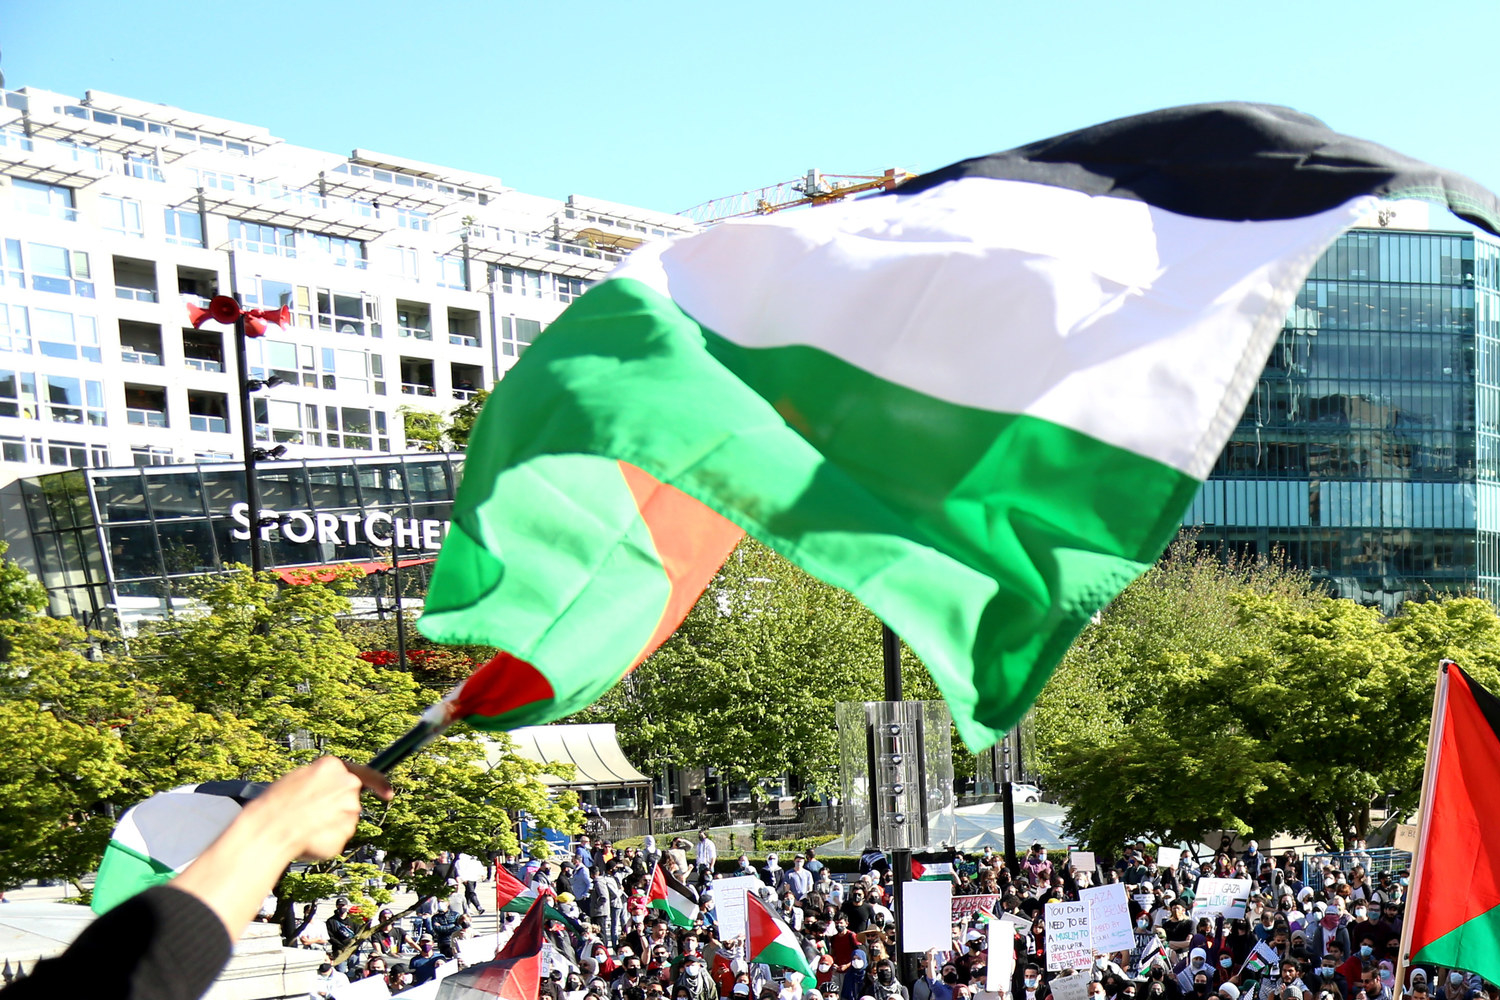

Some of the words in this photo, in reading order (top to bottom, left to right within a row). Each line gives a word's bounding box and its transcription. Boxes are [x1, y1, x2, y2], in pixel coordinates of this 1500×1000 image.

[1222, 883, 1240, 893] GAZA
[1048, 905, 1064, 916] YOU
[1049, 921, 1065, 930] NEED
[1067, 918, 1077, 928] TO
[1079, 917, 1088, 926] BE
[1048, 934, 1054, 942] A
[1080, 930, 1089, 938] TO
